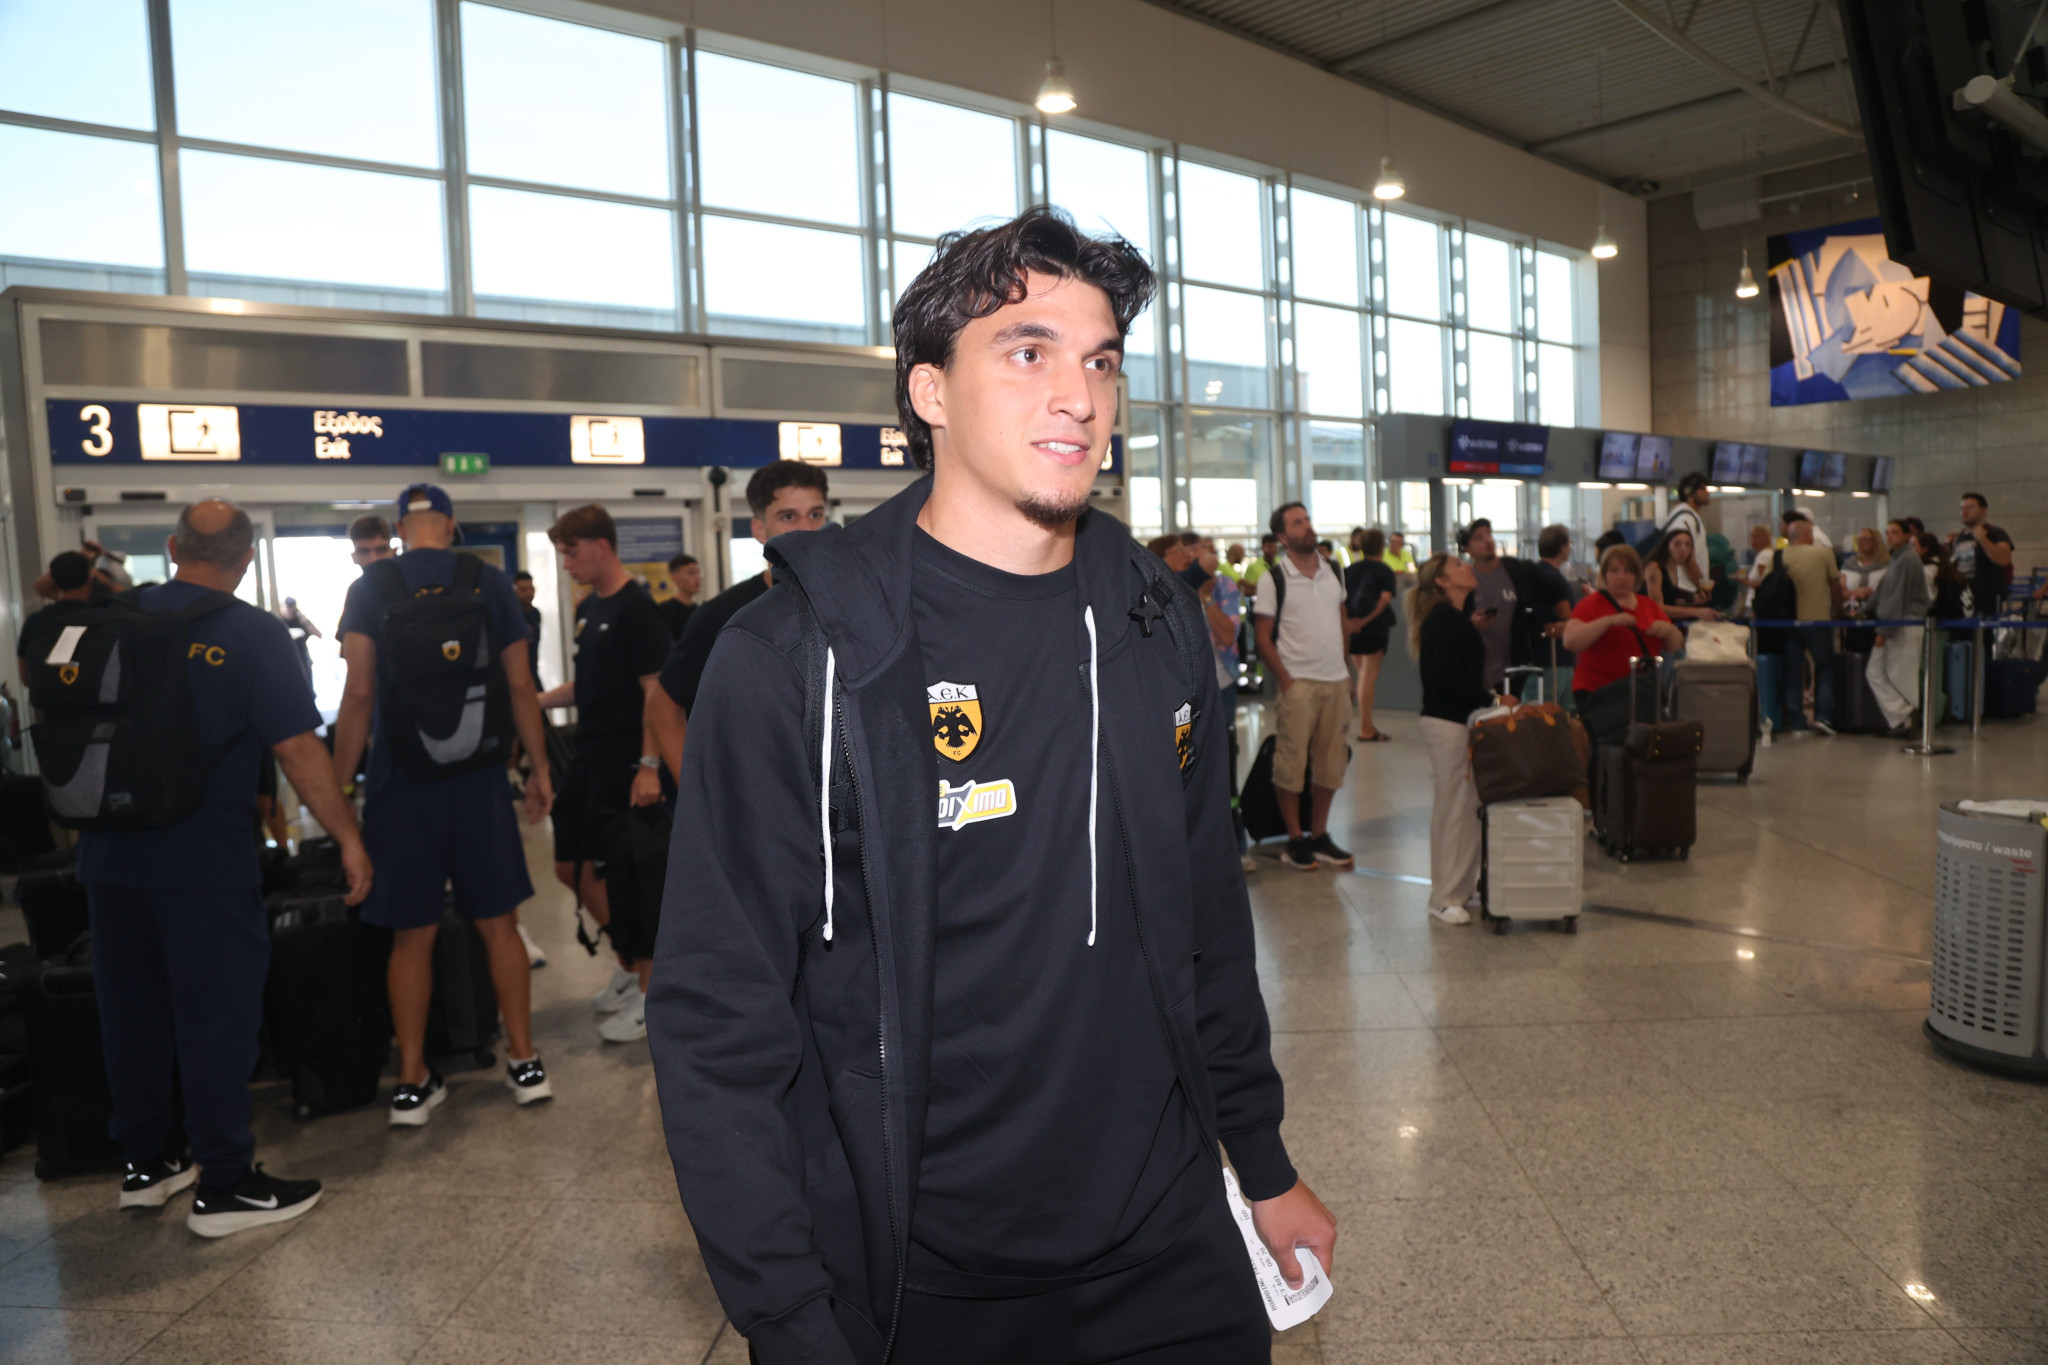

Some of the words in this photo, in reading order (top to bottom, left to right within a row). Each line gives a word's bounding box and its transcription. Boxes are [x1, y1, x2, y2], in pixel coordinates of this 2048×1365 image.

[80, 404, 113, 457] 3
[315, 436, 351, 459] Exit
[188, 642, 226, 666] FC
[1992, 845, 2034, 858] waste
[1259, 1277, 1278, 1312] BOARDING
